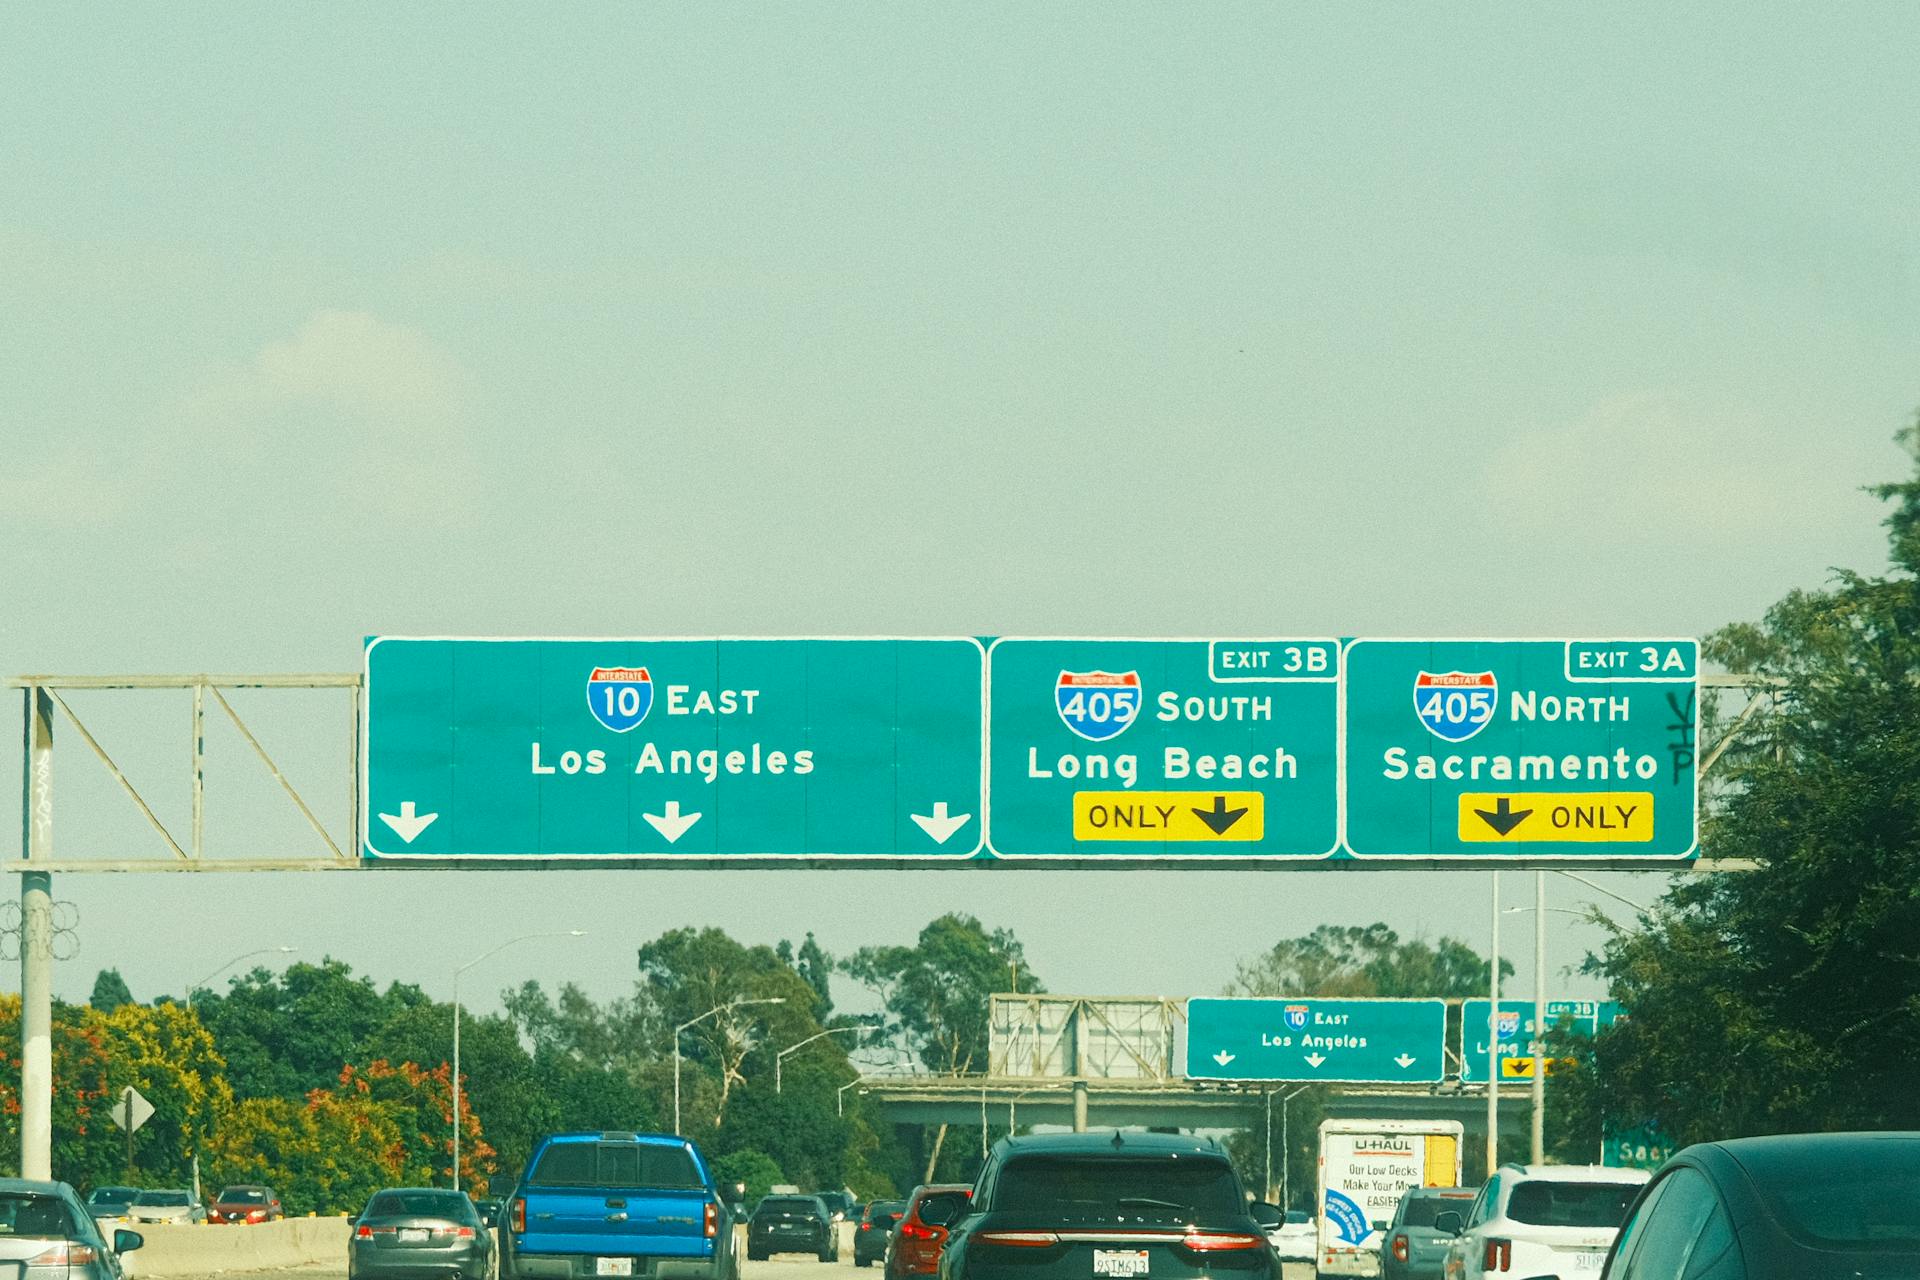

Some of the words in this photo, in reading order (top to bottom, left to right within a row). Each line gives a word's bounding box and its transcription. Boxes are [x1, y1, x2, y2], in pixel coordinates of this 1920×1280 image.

[1222, 651, 1271, 668] EXIT
[1283, 646, 1328, 672] 3B
[1579, 651, 1629, 668] EXIT
[1639, 646, 1686, 672] 3A
[597, 671, 643, 681] INTERSTATE
[1430, 676, 1481, 686] INTERSTATE
[604, 686, 640, 717] 10
[666, 684, 760, 715] EAST
[1062, 691, 1135, 723] 405
[1156, 691, 1272, 722] SOUTH
[1420, 692, 1491, 724] 405
[1510, 690, 1629, 722] NORTH
[531, 742, 606, 775] Los
[635, 742, 815, 785] Angeles
[1028, 746, 1138, 789] Long
[1164, 746, 1298, 780] Beach
[1383, 746, 1658, 781] Sacramento
[1089, 805, 1177, 829] ONLY
[1551, 805, 1638, 830] ONLY
[1291, 1012, 1305, 1026] 10
[1314, 1012, 1349, 1025] EAST
[1261, 1033, 1292, 1047] Los
[1301, 1033, 1367, 1050] Angeles
[1477, 1041, 1519, 1057] Lng
[1355, 1140, 1412, 1151] U-HAUL
[1349, 1164, 1365, 1175] Our
[1367, 1164, 1387, 1176] Low
[1388, 1164, 1418, 1177] Decks
[1343, 1178, 1369, 1191] Make
[1371, 1179, 1393, 1192] Your
